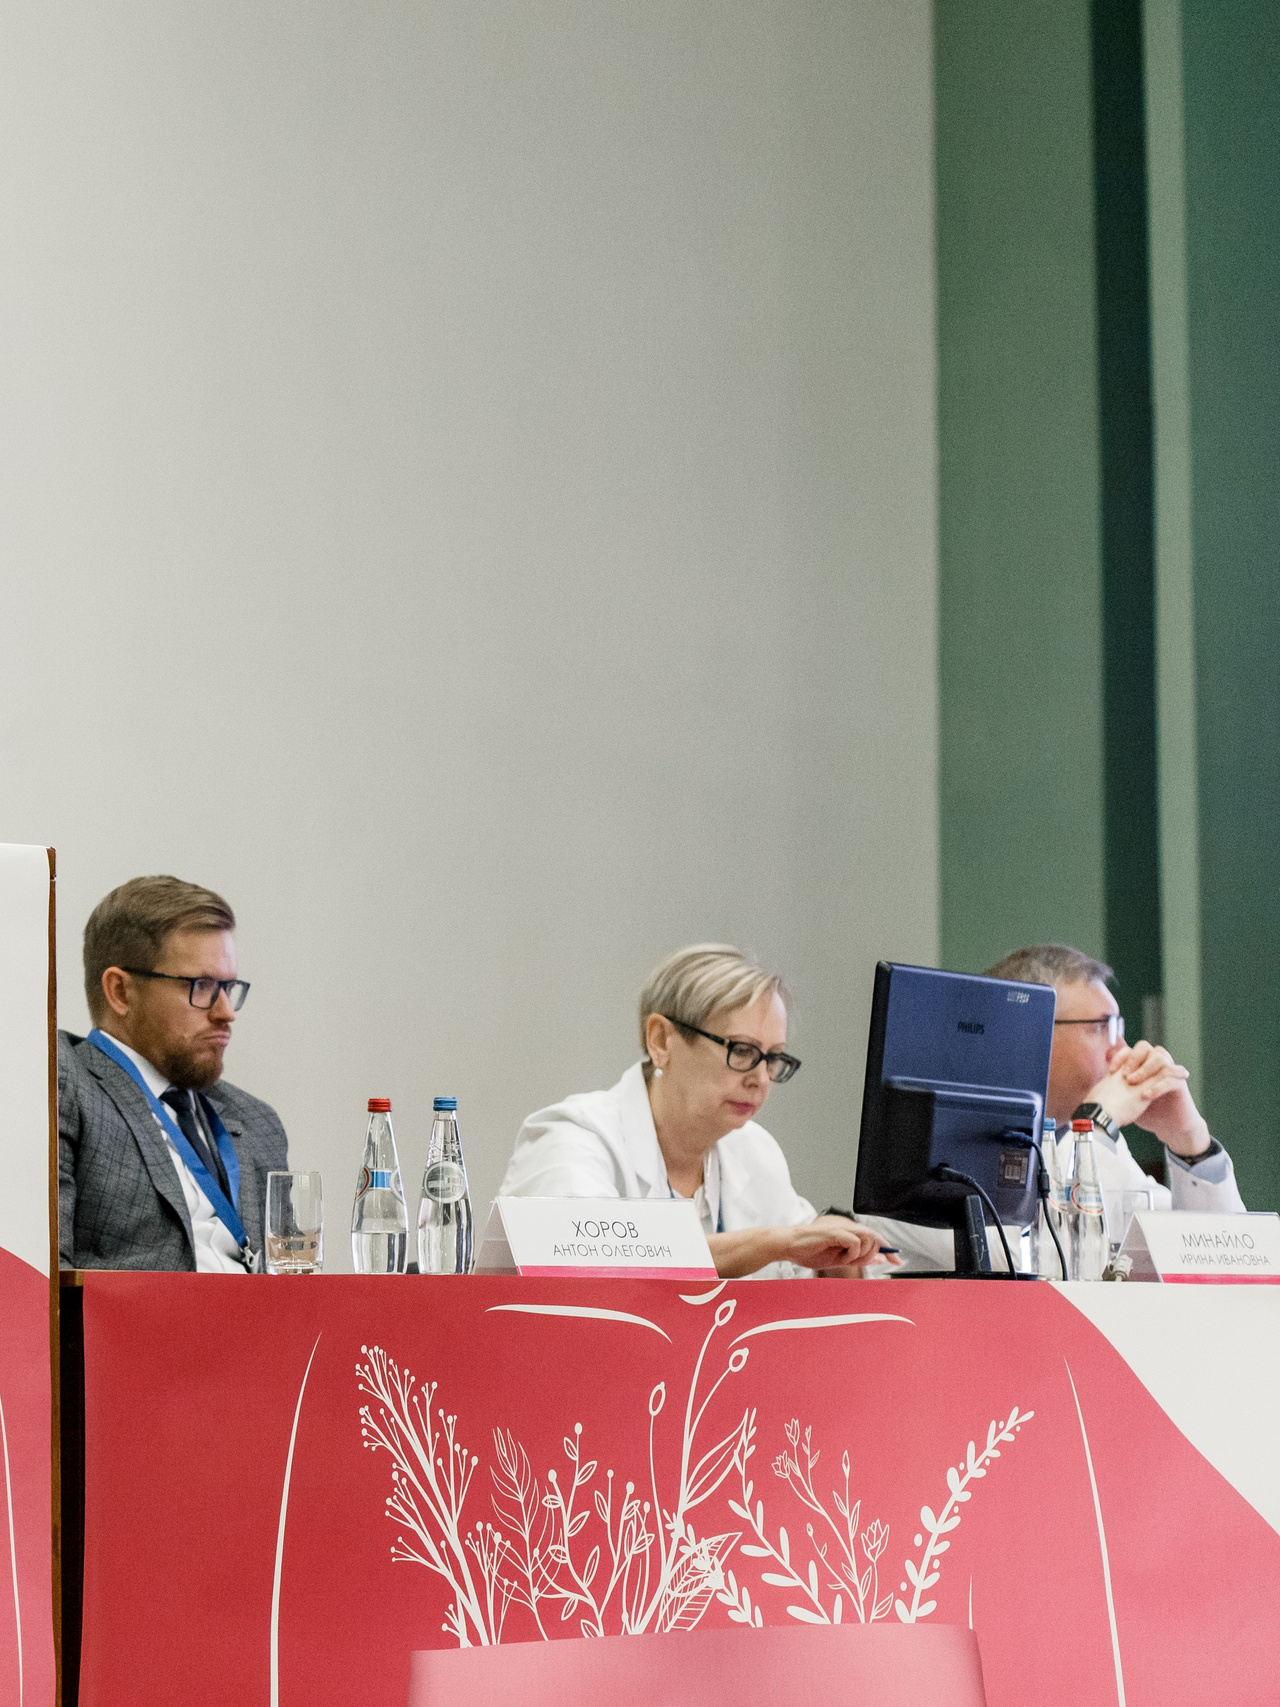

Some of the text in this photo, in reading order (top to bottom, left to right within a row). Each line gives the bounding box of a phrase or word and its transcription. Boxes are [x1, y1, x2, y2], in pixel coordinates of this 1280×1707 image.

[571, 1220, 639, 1239] ХОРОВ
[1181, 1230, 1255, 1250] МИНАЙЛО
[553, 1243, 673, 1258] АНТОН ОЛЕГОВИЧ
[1179, 1253, 1272, 1266] ИРИНА ИВАНОВНА
